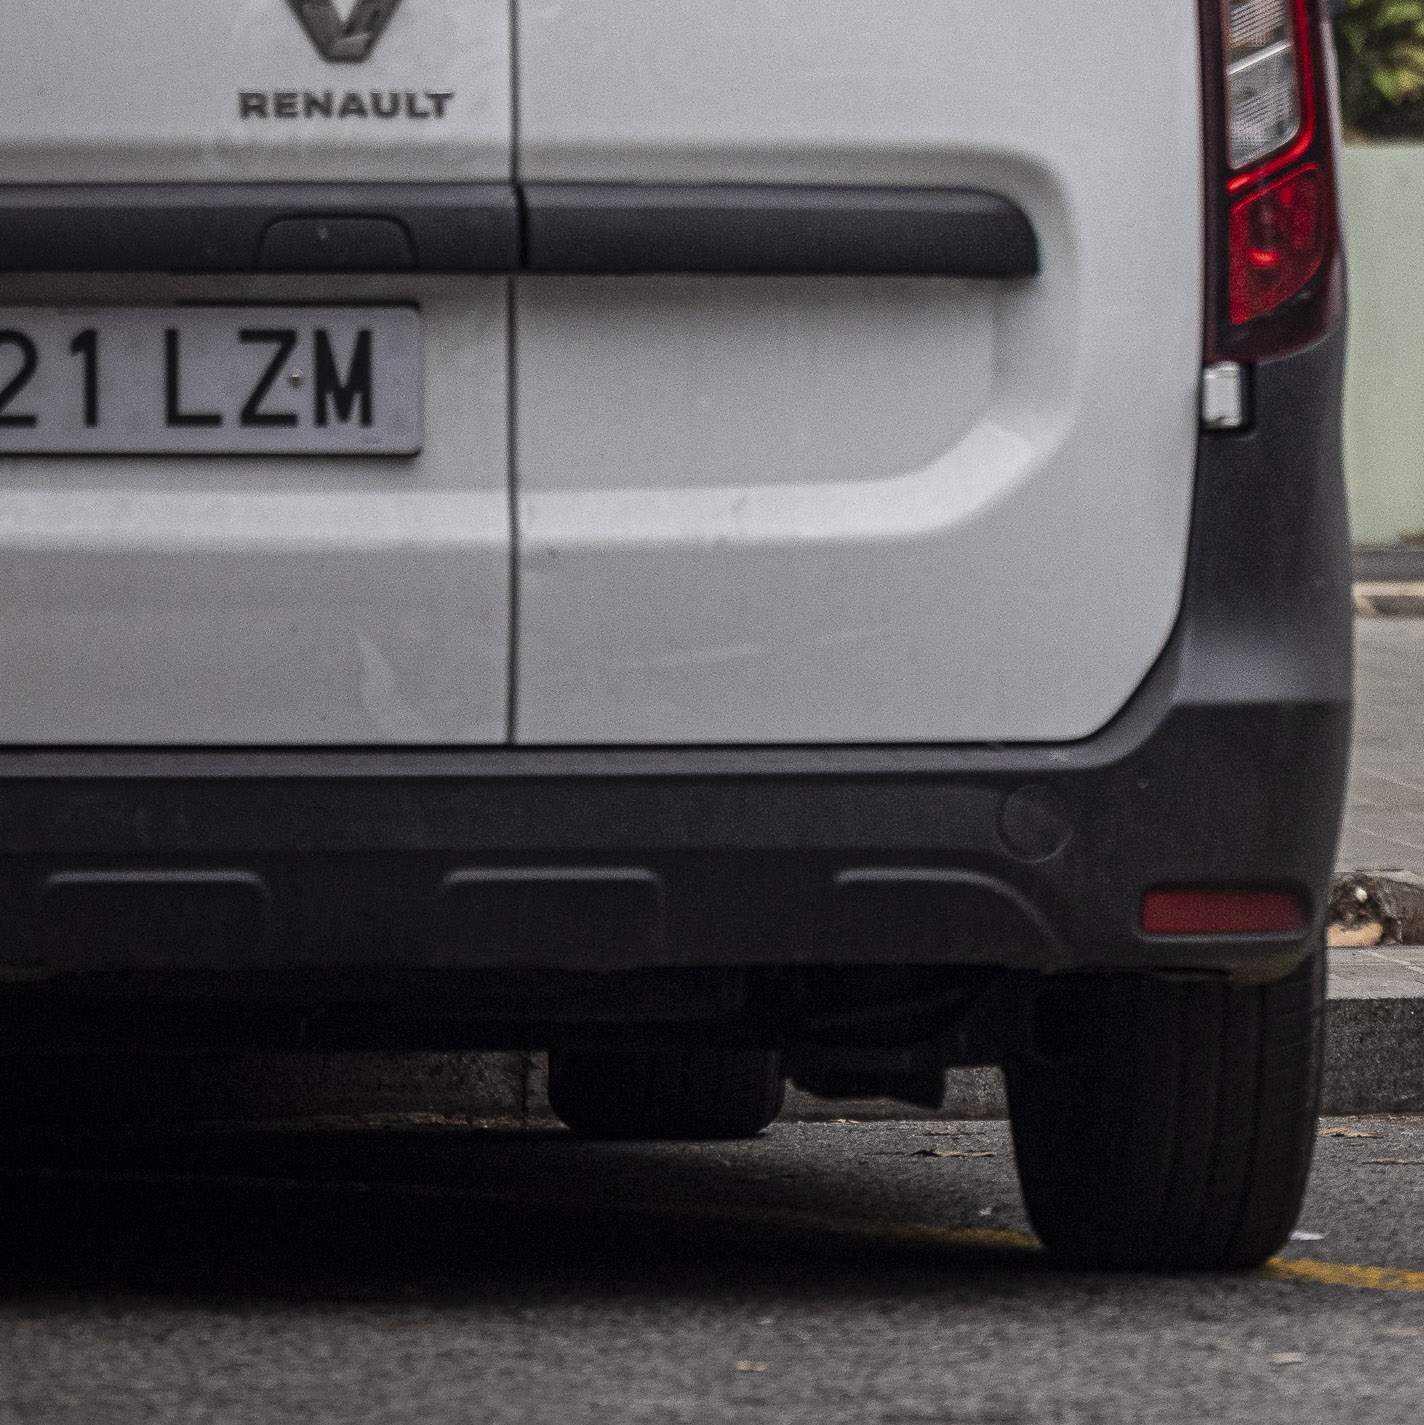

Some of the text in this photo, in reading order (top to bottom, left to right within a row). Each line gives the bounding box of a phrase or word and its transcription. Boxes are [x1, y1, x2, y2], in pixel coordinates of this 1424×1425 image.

[238, 90, 454, 120] RENAULT
[0, 328, 372, 428] 21 LZM
